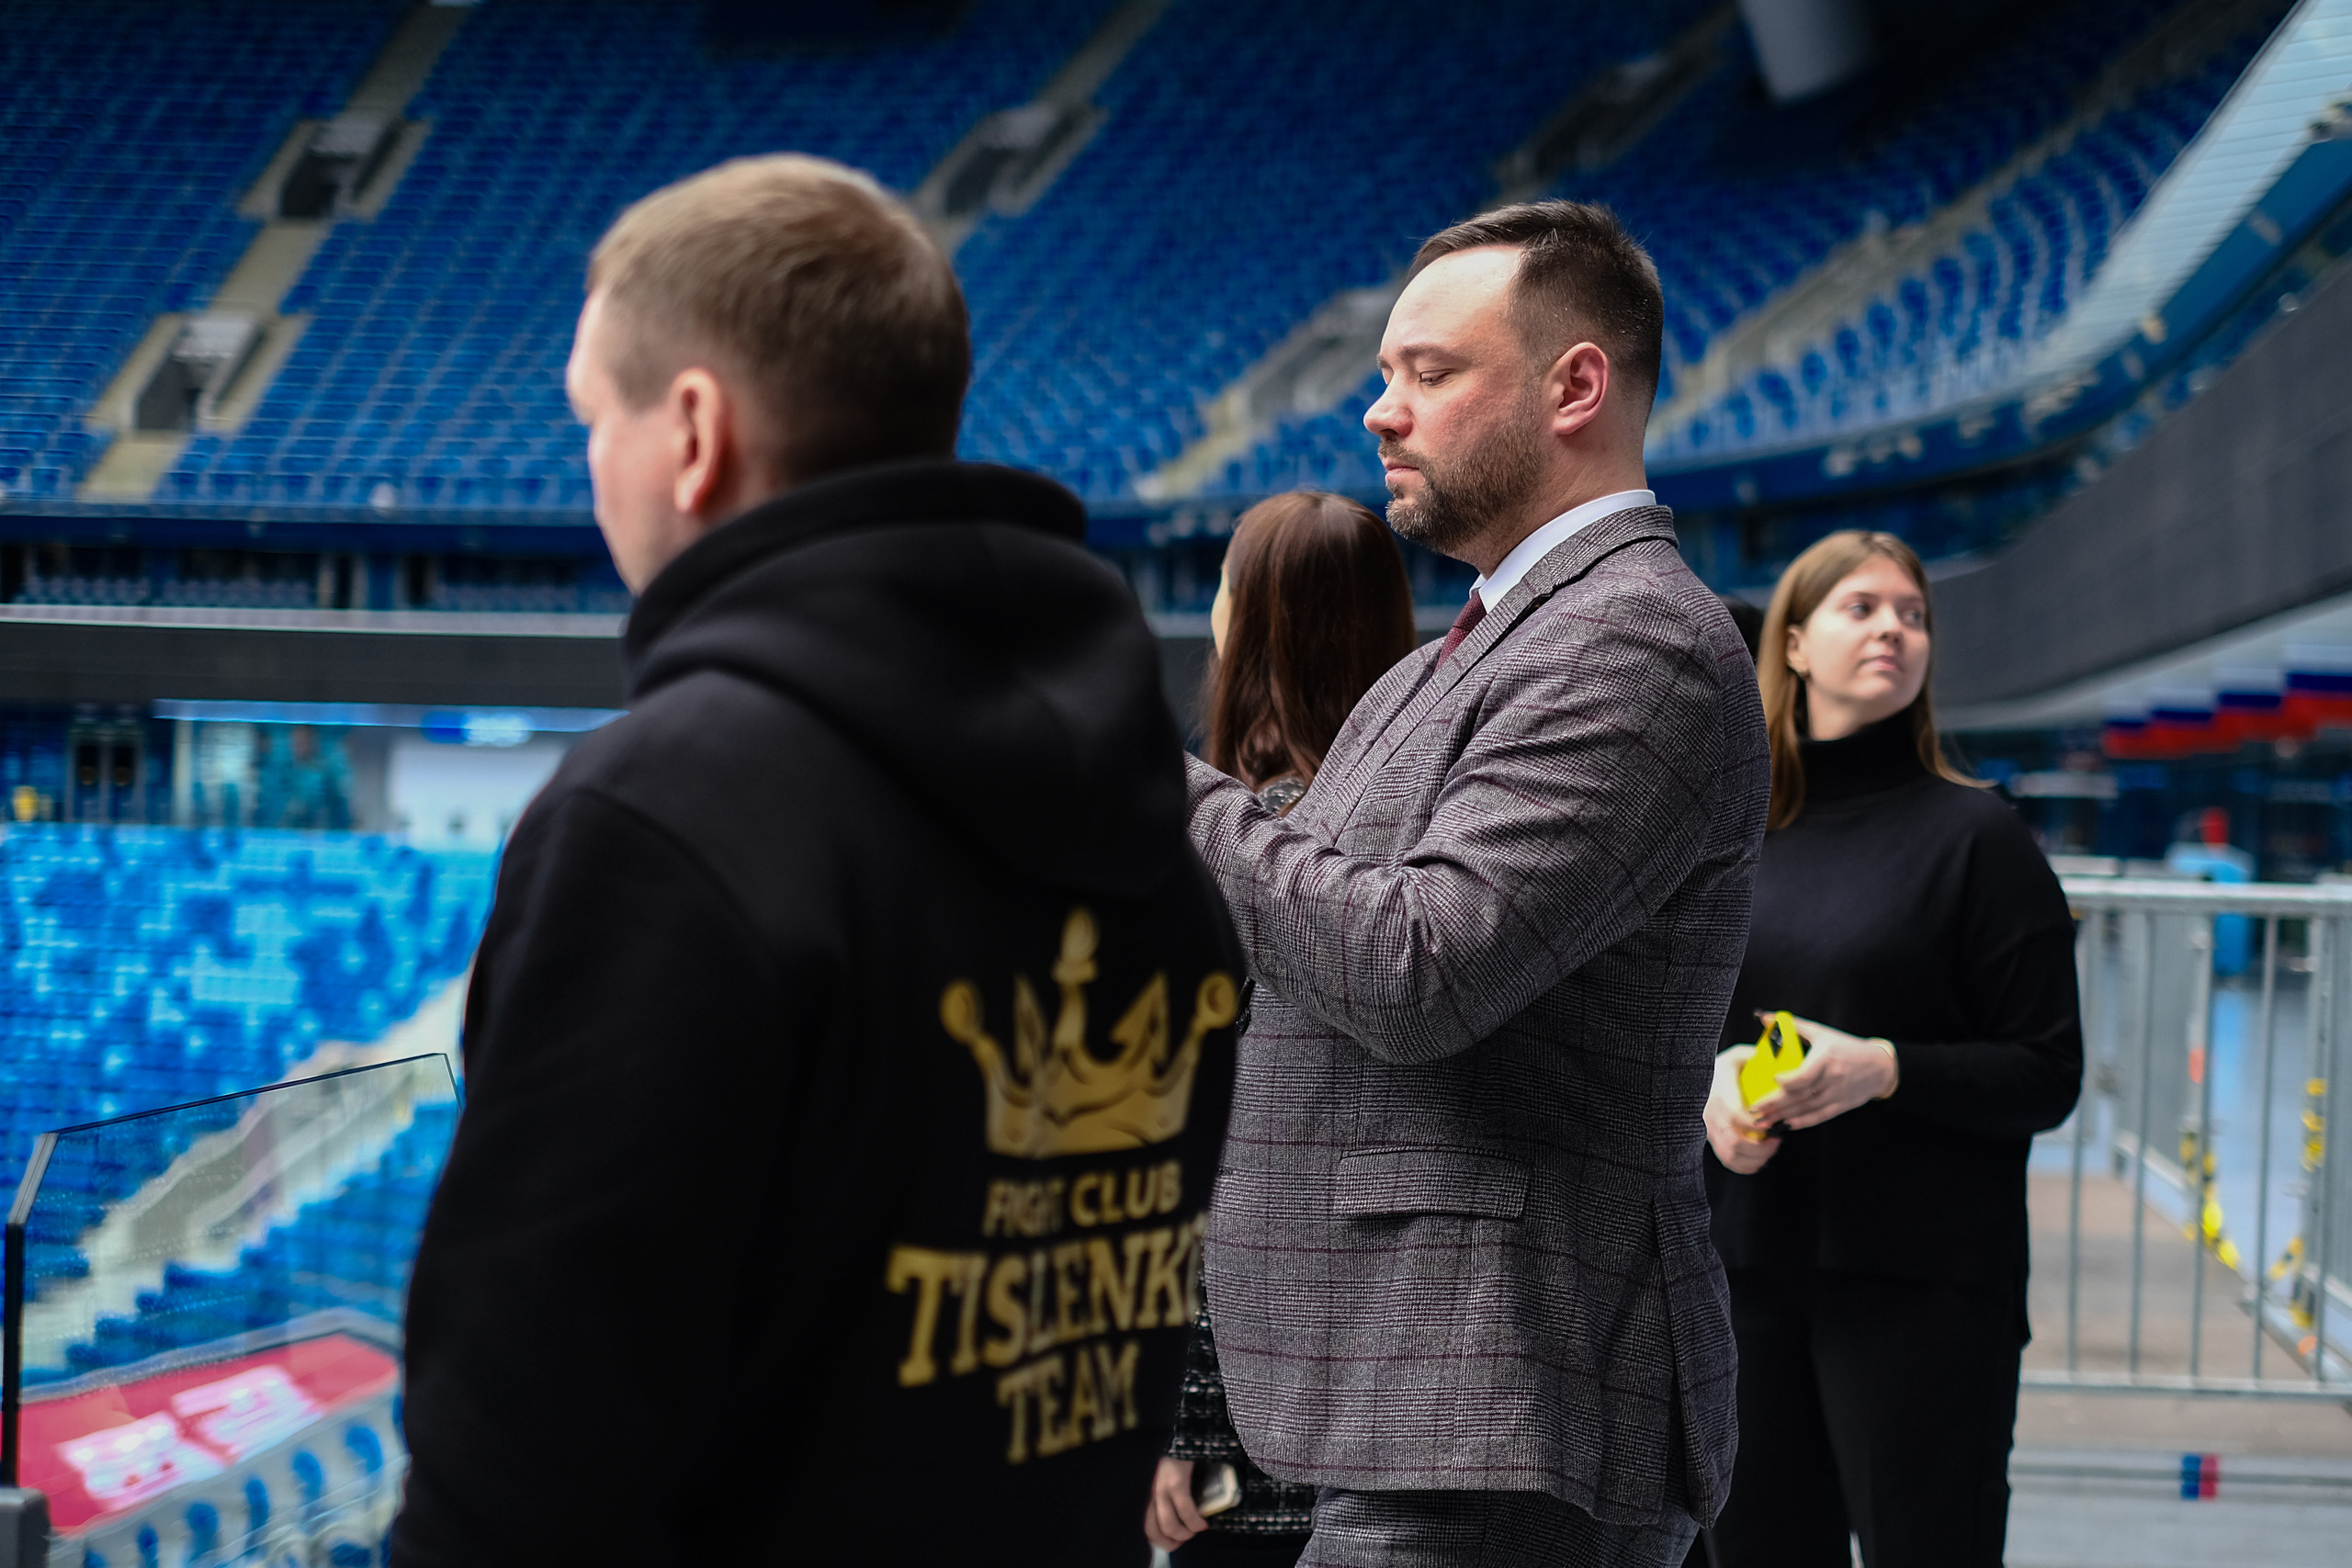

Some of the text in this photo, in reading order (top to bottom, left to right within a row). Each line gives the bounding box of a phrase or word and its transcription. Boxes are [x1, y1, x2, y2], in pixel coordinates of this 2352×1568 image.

[982, 1161, 1182, 1237] FIGT CLUB
[995, 1338, 1140, 1466] TEAM
